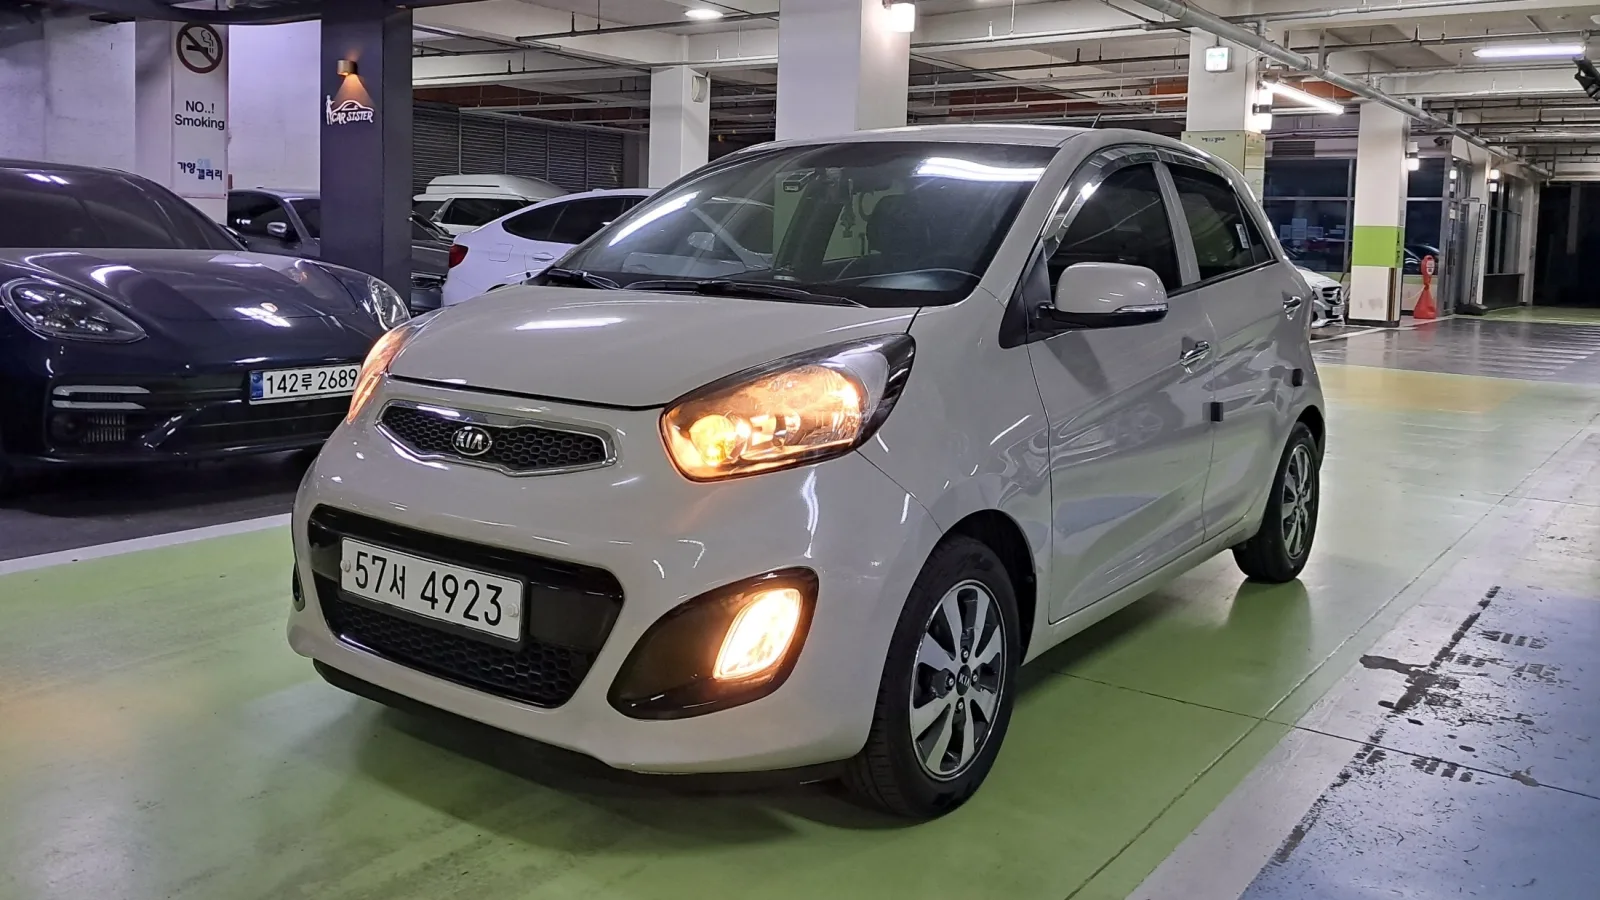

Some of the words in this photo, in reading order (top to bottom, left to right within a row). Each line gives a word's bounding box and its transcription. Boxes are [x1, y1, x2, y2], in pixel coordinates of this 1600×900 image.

[185, 100, 215, 114] NO..!
[174, 113, 225, 131] Smoking
[331, 111, 347, 124] CAR
[346, 110, 374, 123] SISTER
[177, 161, 196, 174] 가양
[266, 373, 313, 395] 142루
[318, 368, 358, 390] 2689
[455, 430, 483, 451] KIA
[355, 551, 406, 600] 57서
[420, 571, 503, 626] 4923
[958, 672, 970, 687] KIA
